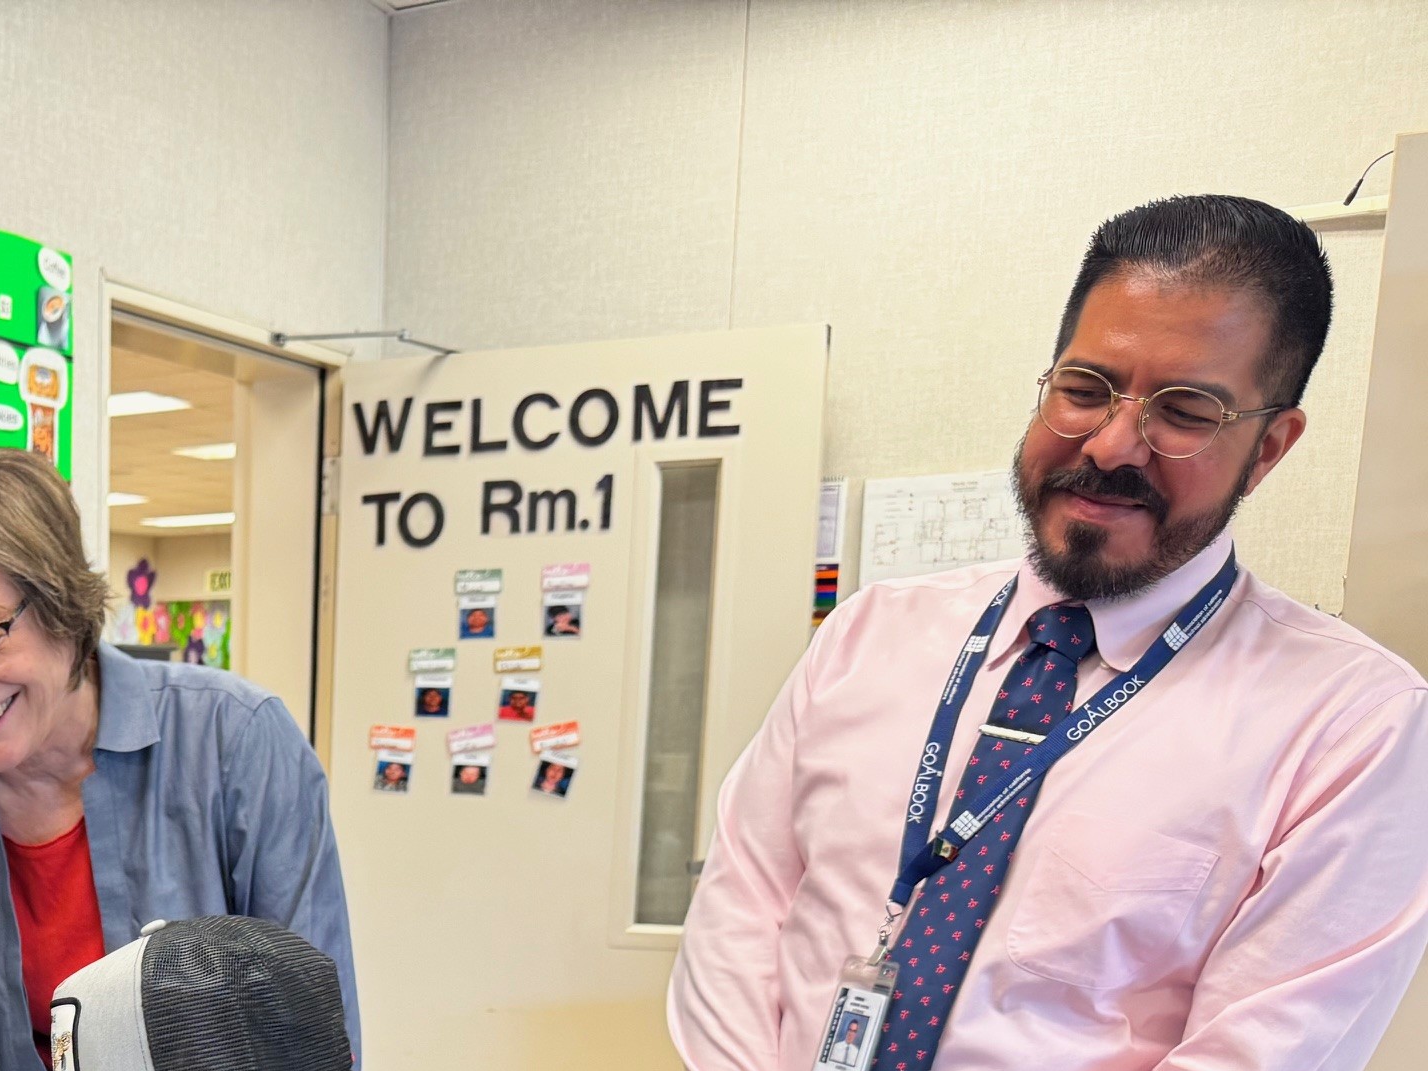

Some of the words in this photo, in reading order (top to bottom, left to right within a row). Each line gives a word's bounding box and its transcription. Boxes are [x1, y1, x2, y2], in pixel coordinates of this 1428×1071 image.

[353, 378, 743, 456] WELCOME
[362, 491, 446, 549] TO
[480, 474, 615, 536] Rm.1
[1066, 674, 1144, 741] GOALBOOK
[907, 741, 942, 825] GOALBOOK
[1008, 767, 1031, 789] california
